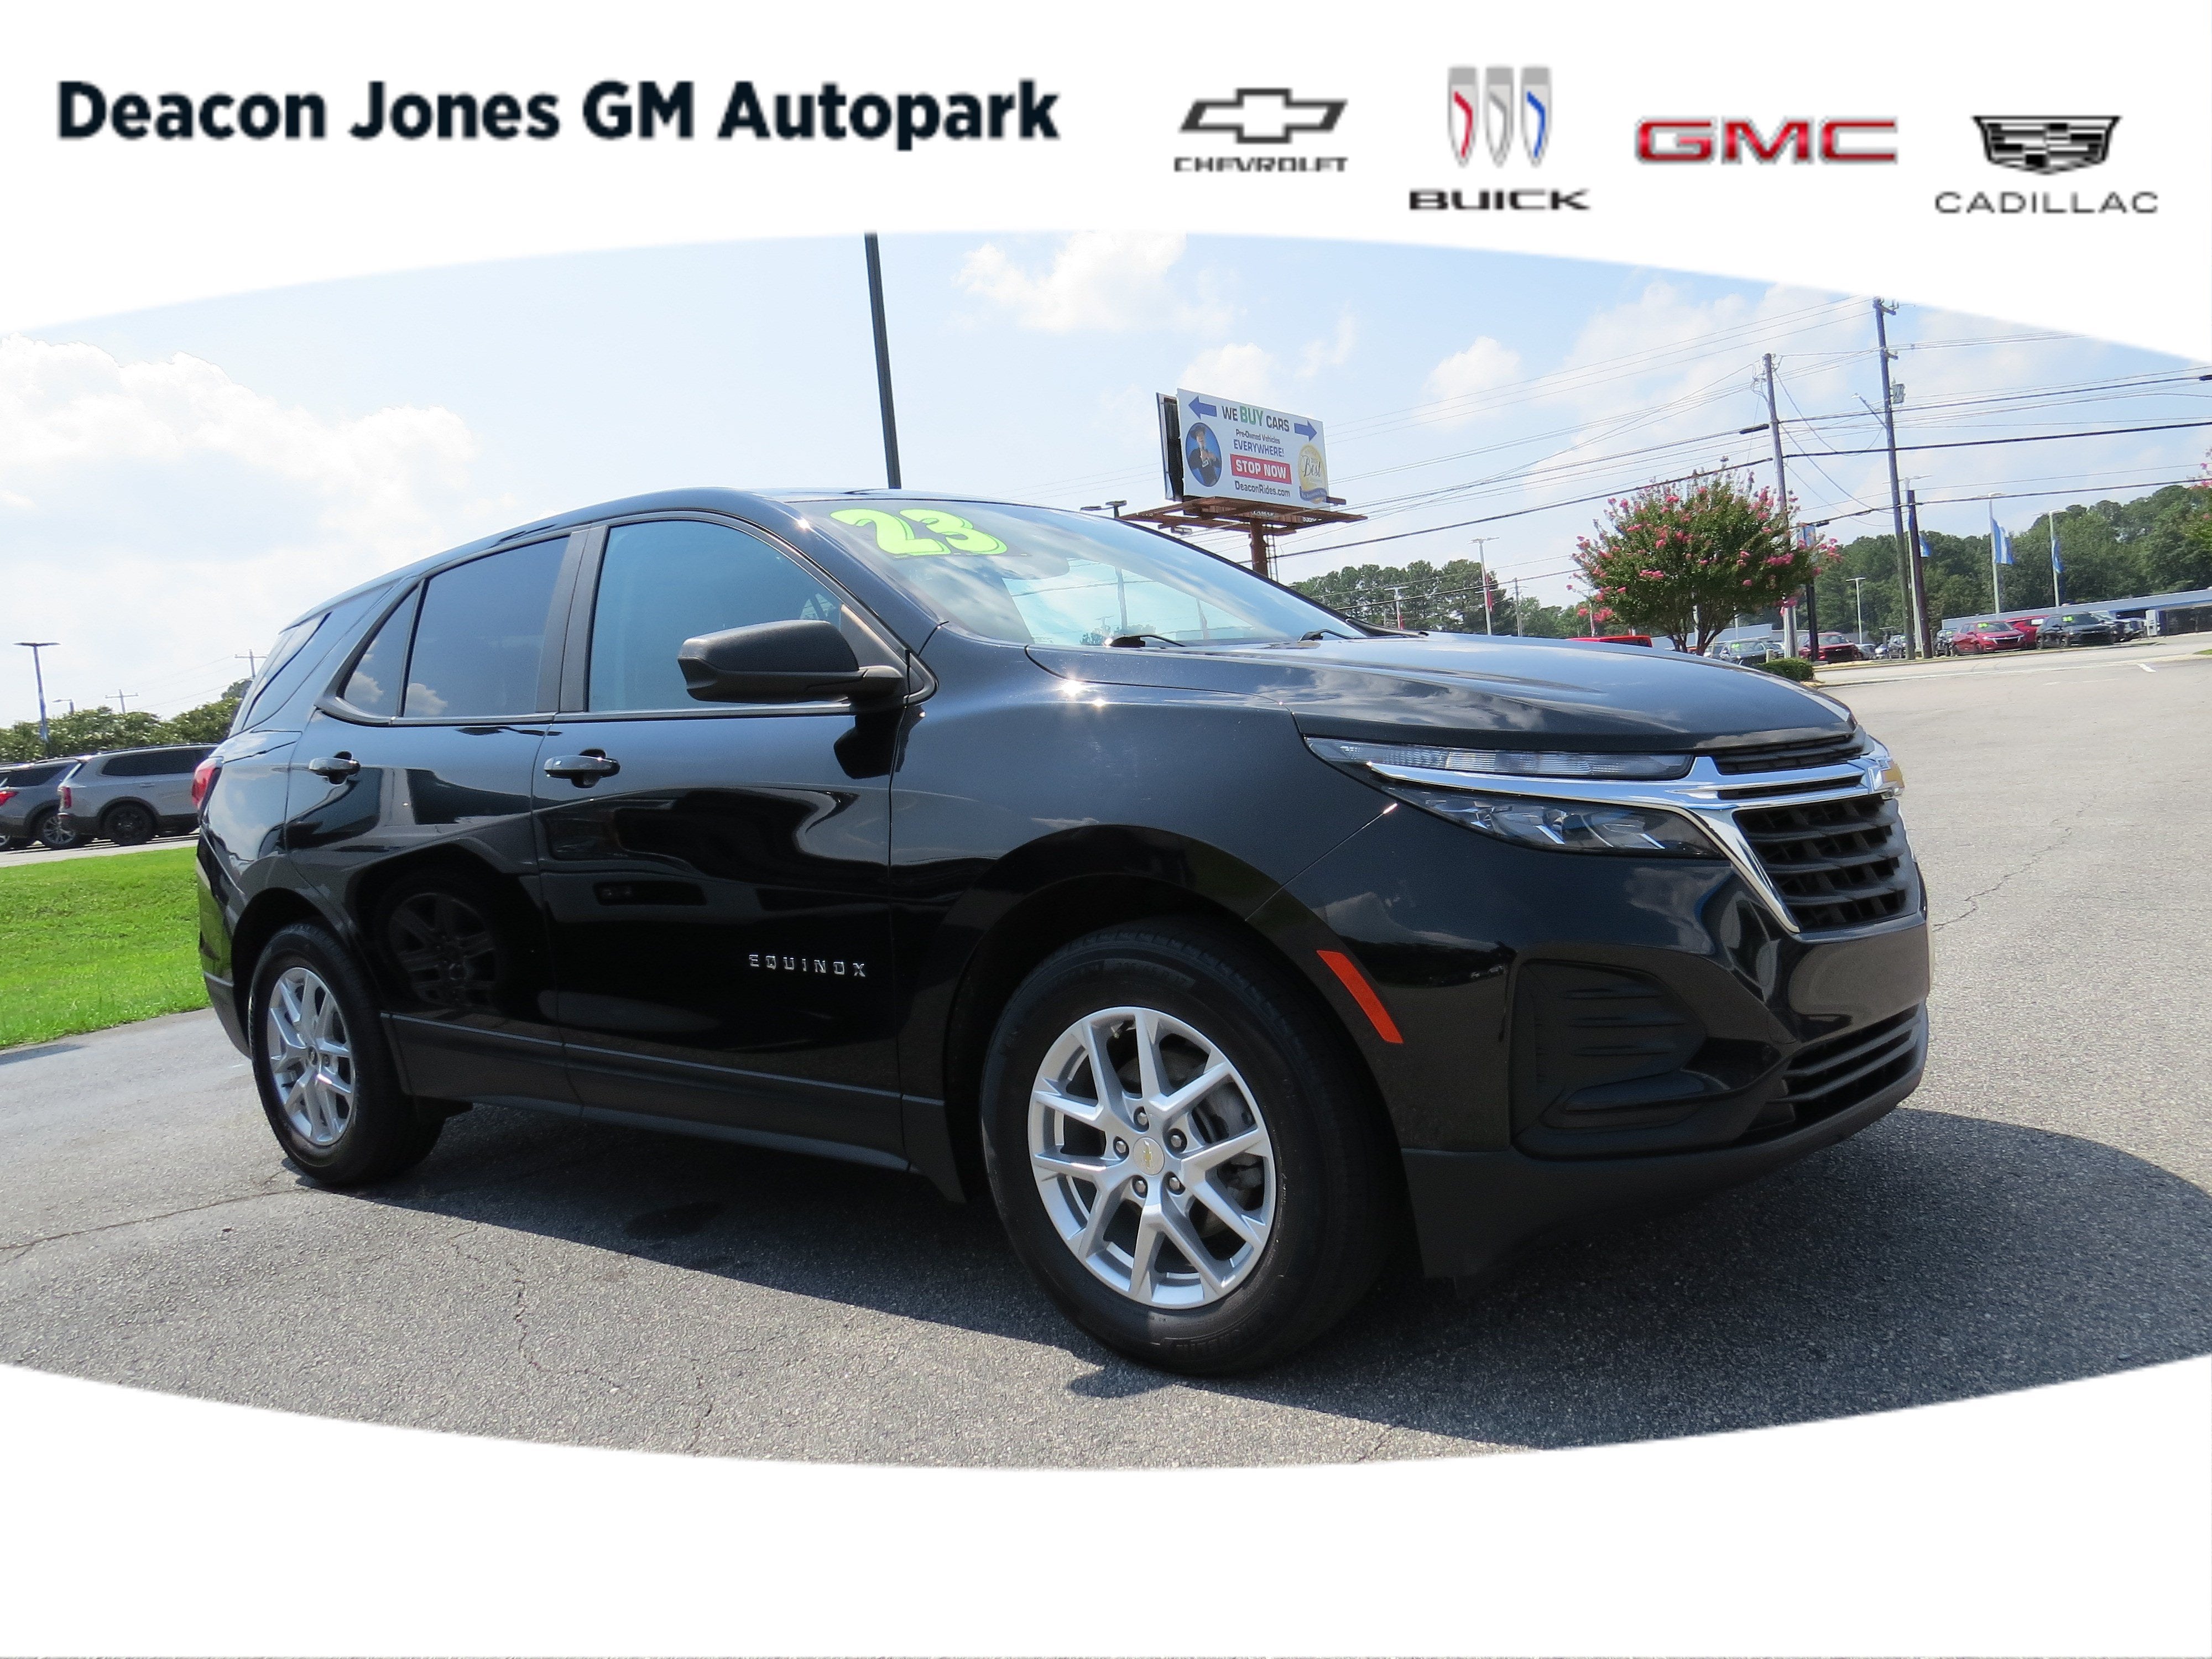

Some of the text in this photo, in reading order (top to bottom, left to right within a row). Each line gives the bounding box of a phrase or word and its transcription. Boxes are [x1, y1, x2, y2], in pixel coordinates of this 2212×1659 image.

[1222, 405, 1290, 432] WE BUY CARS
[1235, 429, 1280, 444] Pre-Owned Vehicles
[1234, 439, 1285, 457] EVERYWHERE!
[1235, 459, 1287, 479] STOP NOW
[1234, 480, 1291, 497] DeaconRides.com
[830, 508, 1008, 556] 23
[749, 954, 866, 978] EQUINOX
